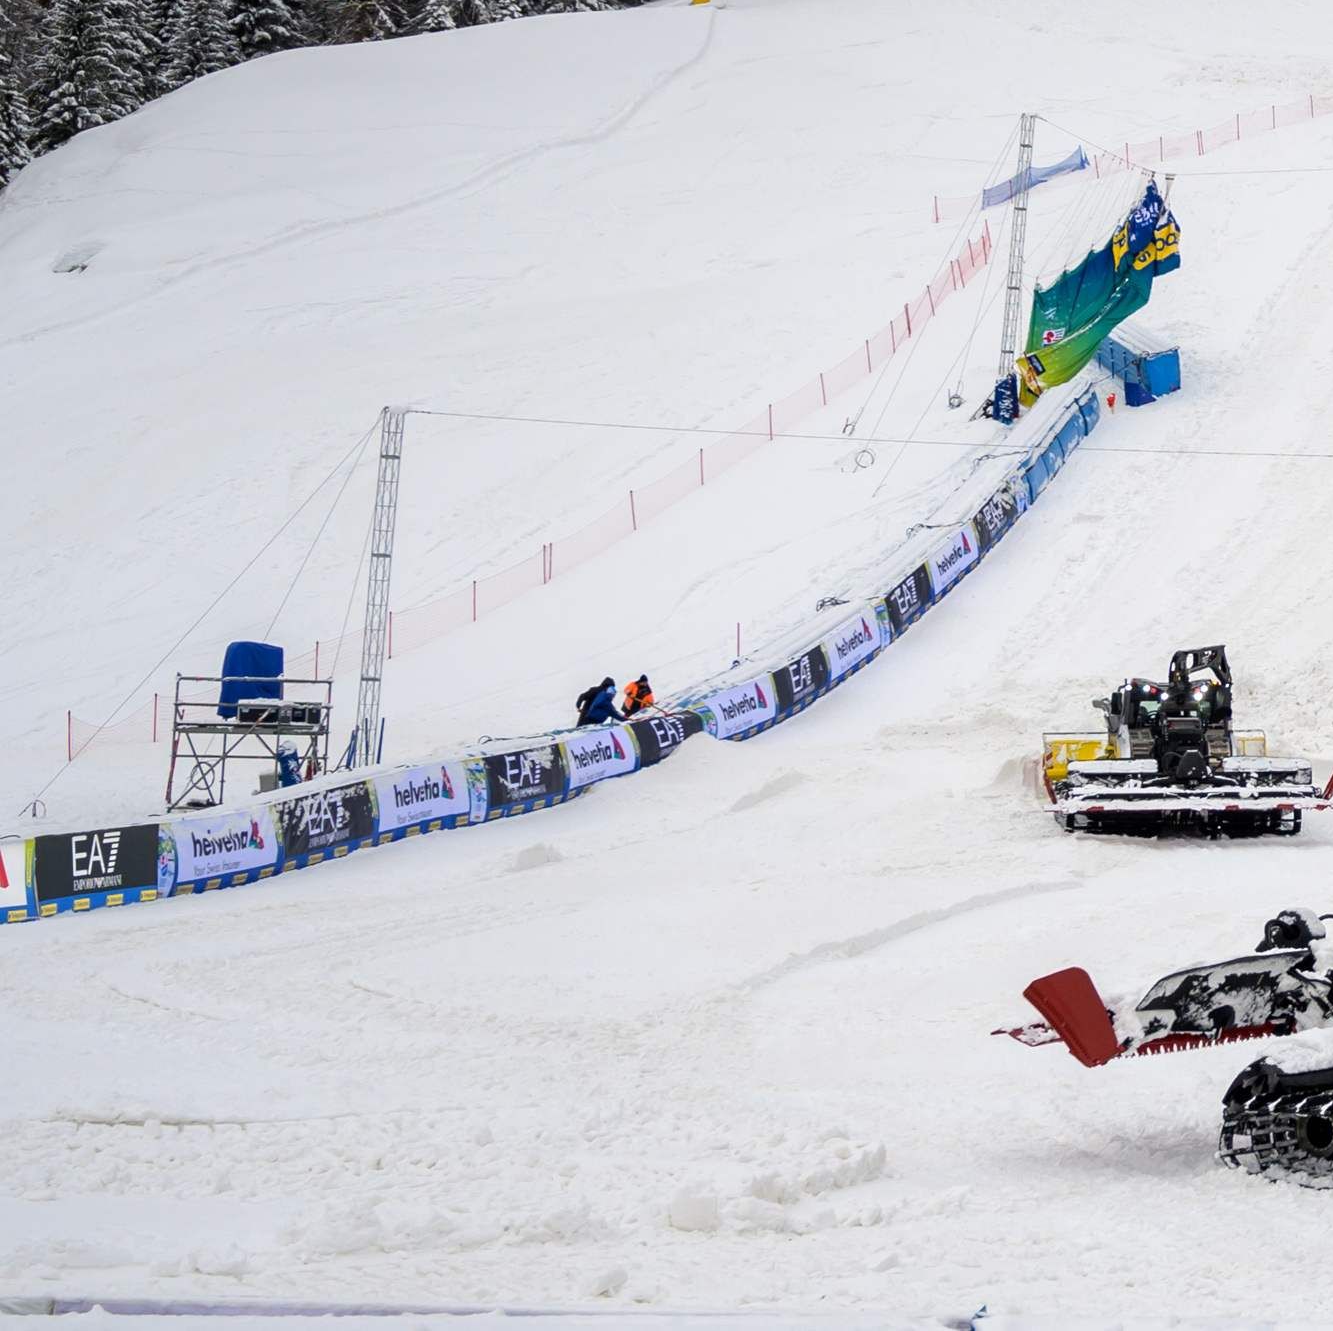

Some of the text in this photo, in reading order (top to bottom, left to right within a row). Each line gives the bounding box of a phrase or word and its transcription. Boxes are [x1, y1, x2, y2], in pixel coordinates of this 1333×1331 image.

[894, 575, 918, 614] EA7
[718, 693, 757, 721] helvetia
[649, 716, 684, 747] EA7
[571, 740, 613, 770] helvetia
[393, 776, 440, 808] helvetia
[72, 831, 121, 876] EA7
